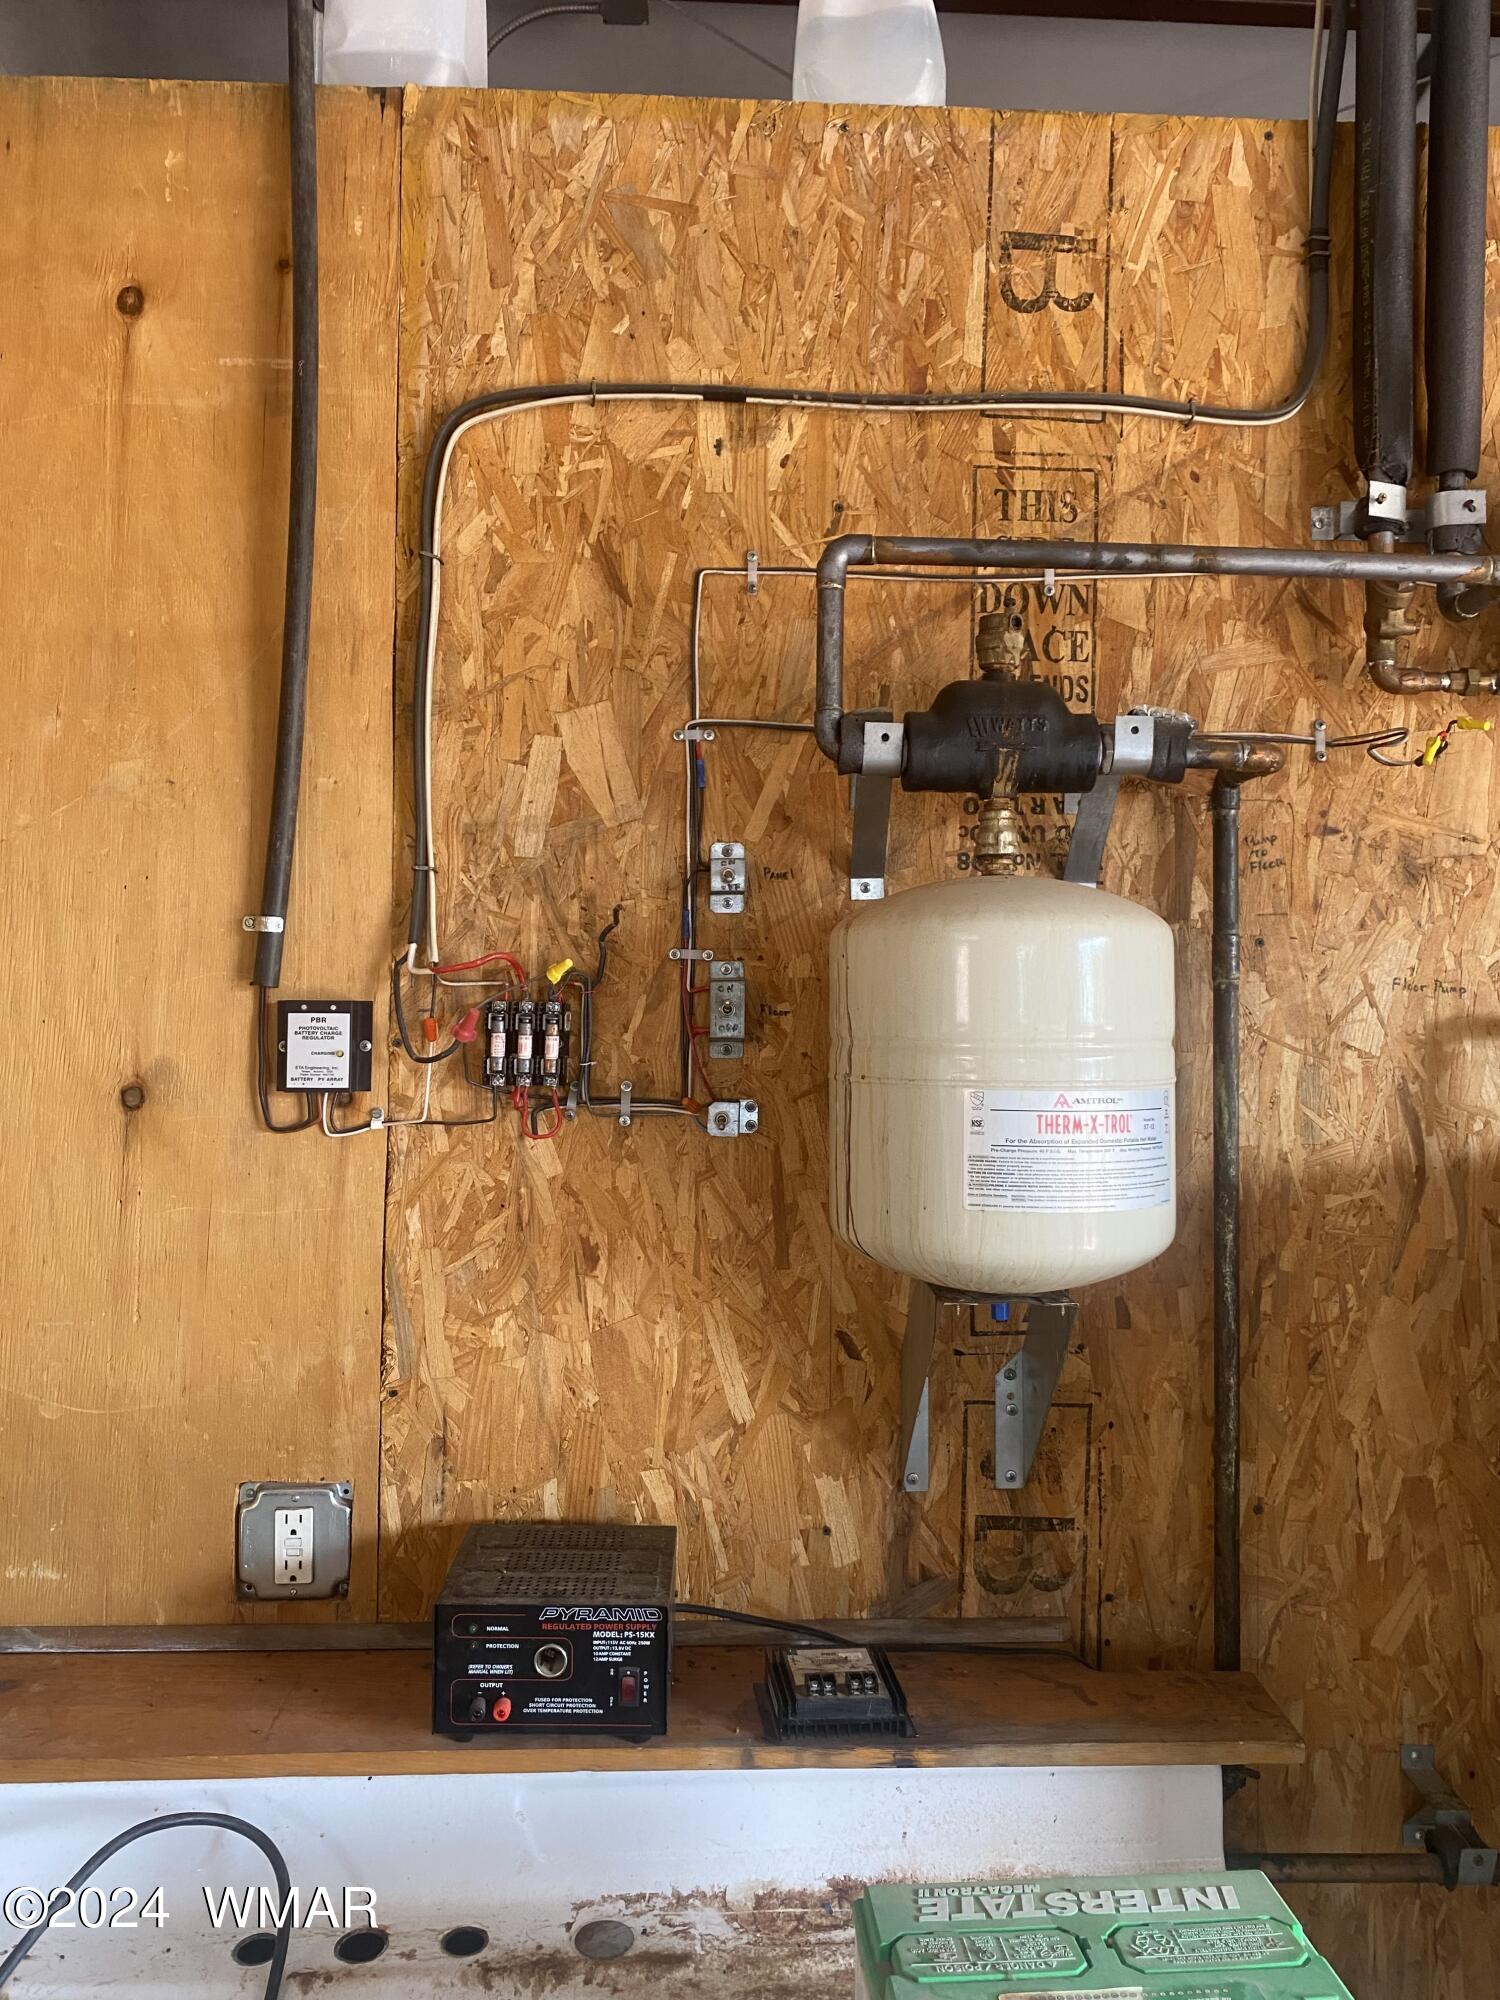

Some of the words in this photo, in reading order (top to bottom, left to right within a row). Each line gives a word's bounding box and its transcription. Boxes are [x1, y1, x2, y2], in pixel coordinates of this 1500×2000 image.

[994, 488, 1078, 523] THIS
[977, 582, 1091, 615] DOWN
[539, 1607, 663, 1621] PYRAMID
[918, 1885, 1241, 1923] INTERSTATE
[935, 1963, 984, 1973] POISON
[995, 1961, 1046, 1970] DANGER
